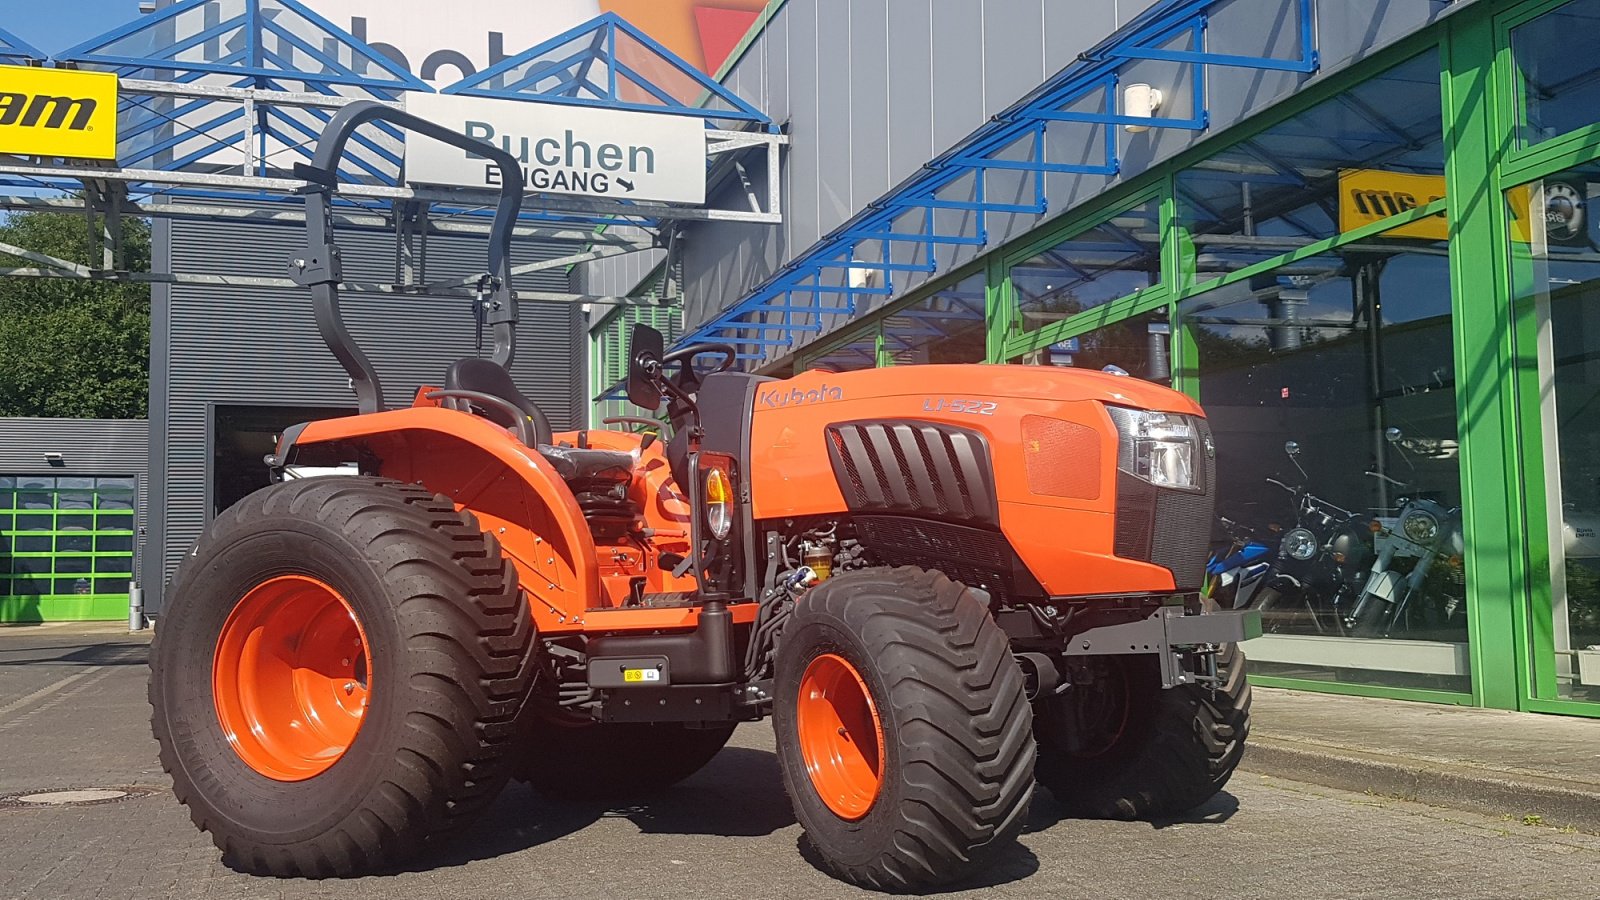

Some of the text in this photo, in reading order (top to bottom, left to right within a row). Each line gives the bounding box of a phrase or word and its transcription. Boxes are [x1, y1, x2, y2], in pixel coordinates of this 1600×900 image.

[464, 120, 655, 174] Buchen
[485, 164, 609, 193] EGANG
[759, 384, 843, 407] Kubota
[922, 397, 998, 416] L1-522
